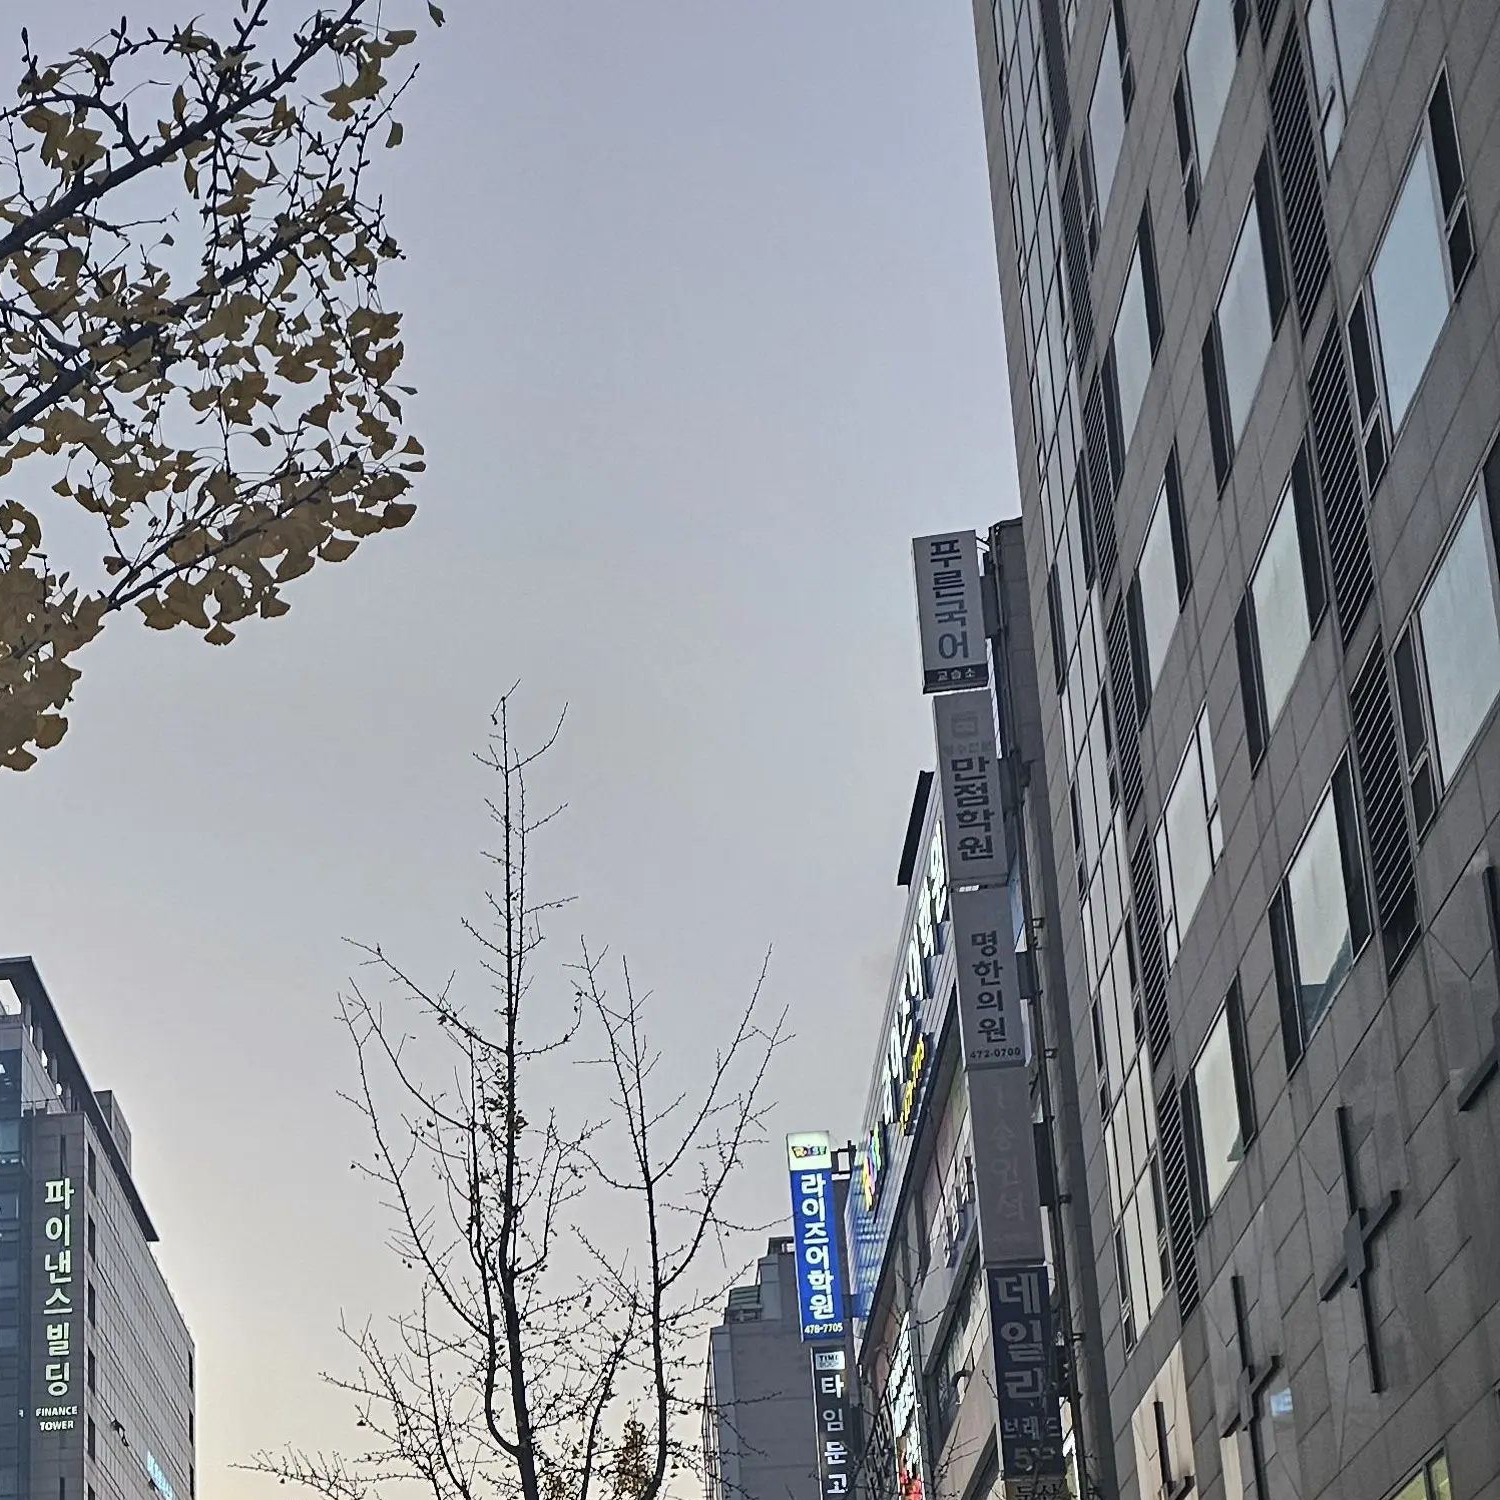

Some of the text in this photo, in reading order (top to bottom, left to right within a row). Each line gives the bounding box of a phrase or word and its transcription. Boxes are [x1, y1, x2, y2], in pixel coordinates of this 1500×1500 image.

[928, 538, 972, 663] 푸른국어
[43, 1176, 75, 1398] 파이낸스빌딩
[800, 1172, 835, 1321] 라이즈어학원
[803, 1321, 844, 1335] 478-7705
[993, 1272, 1048, 1413] 데일리
[35, 1404, 79, 1418] FINANCE
[39, 1419, 75, 1432] TOWER
[819, 1376, 848, 1495] 타임문고
